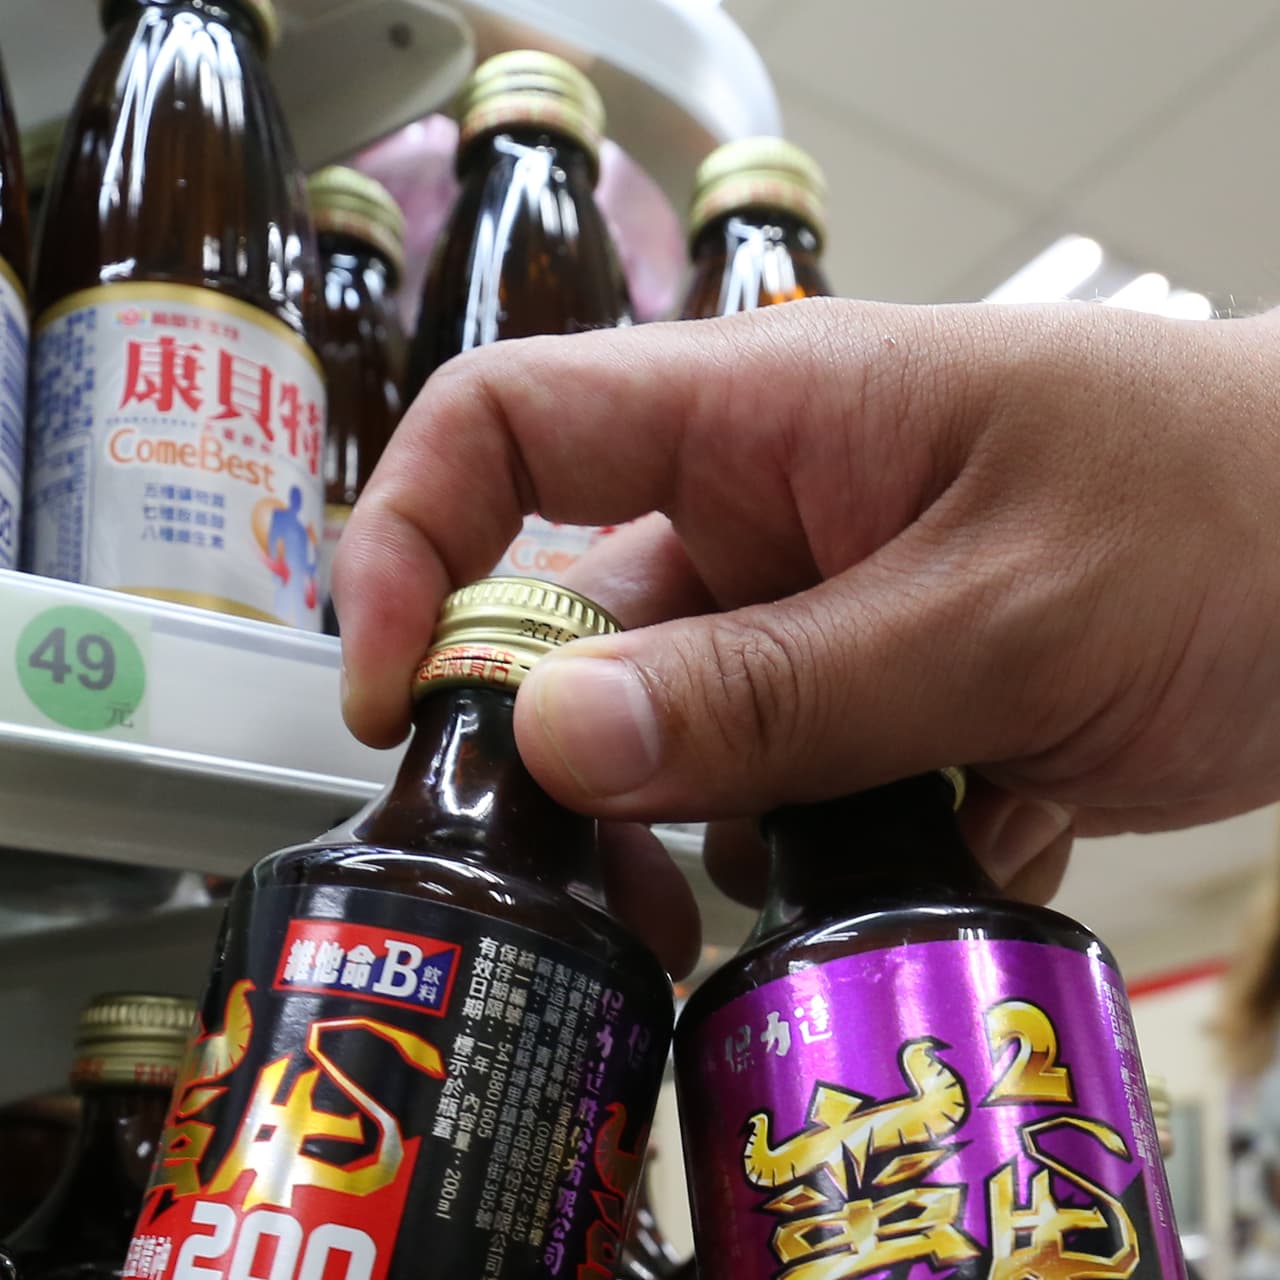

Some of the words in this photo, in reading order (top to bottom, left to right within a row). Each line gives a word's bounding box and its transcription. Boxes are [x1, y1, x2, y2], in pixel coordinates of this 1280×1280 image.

[119, 336, 320, 476] 康貝特
[109, 427, 277, 493] ComeBest
[28, 626, 118, 693] 49
